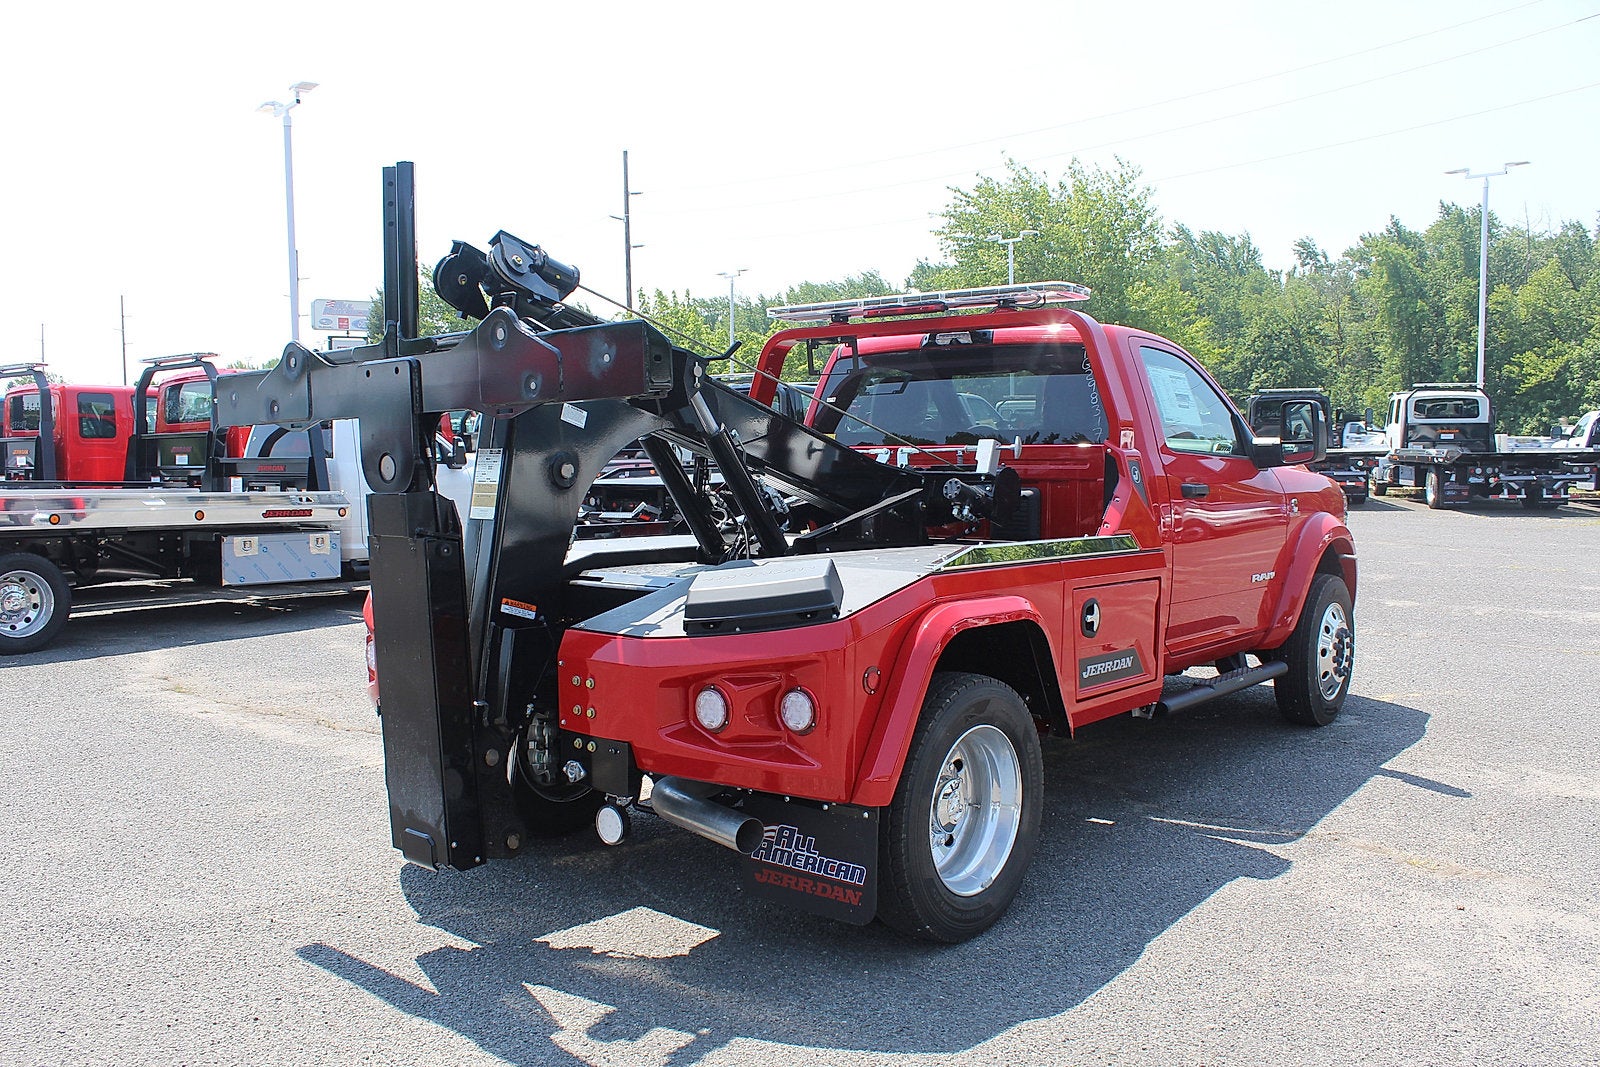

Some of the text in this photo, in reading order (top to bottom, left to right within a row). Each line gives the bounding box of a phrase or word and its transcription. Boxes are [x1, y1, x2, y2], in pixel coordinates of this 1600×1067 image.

[1251, 571, 1276, 583] RAM
[774, 824, 819, 859] ALL
[751, 837, 867, 886] AMERICAN
